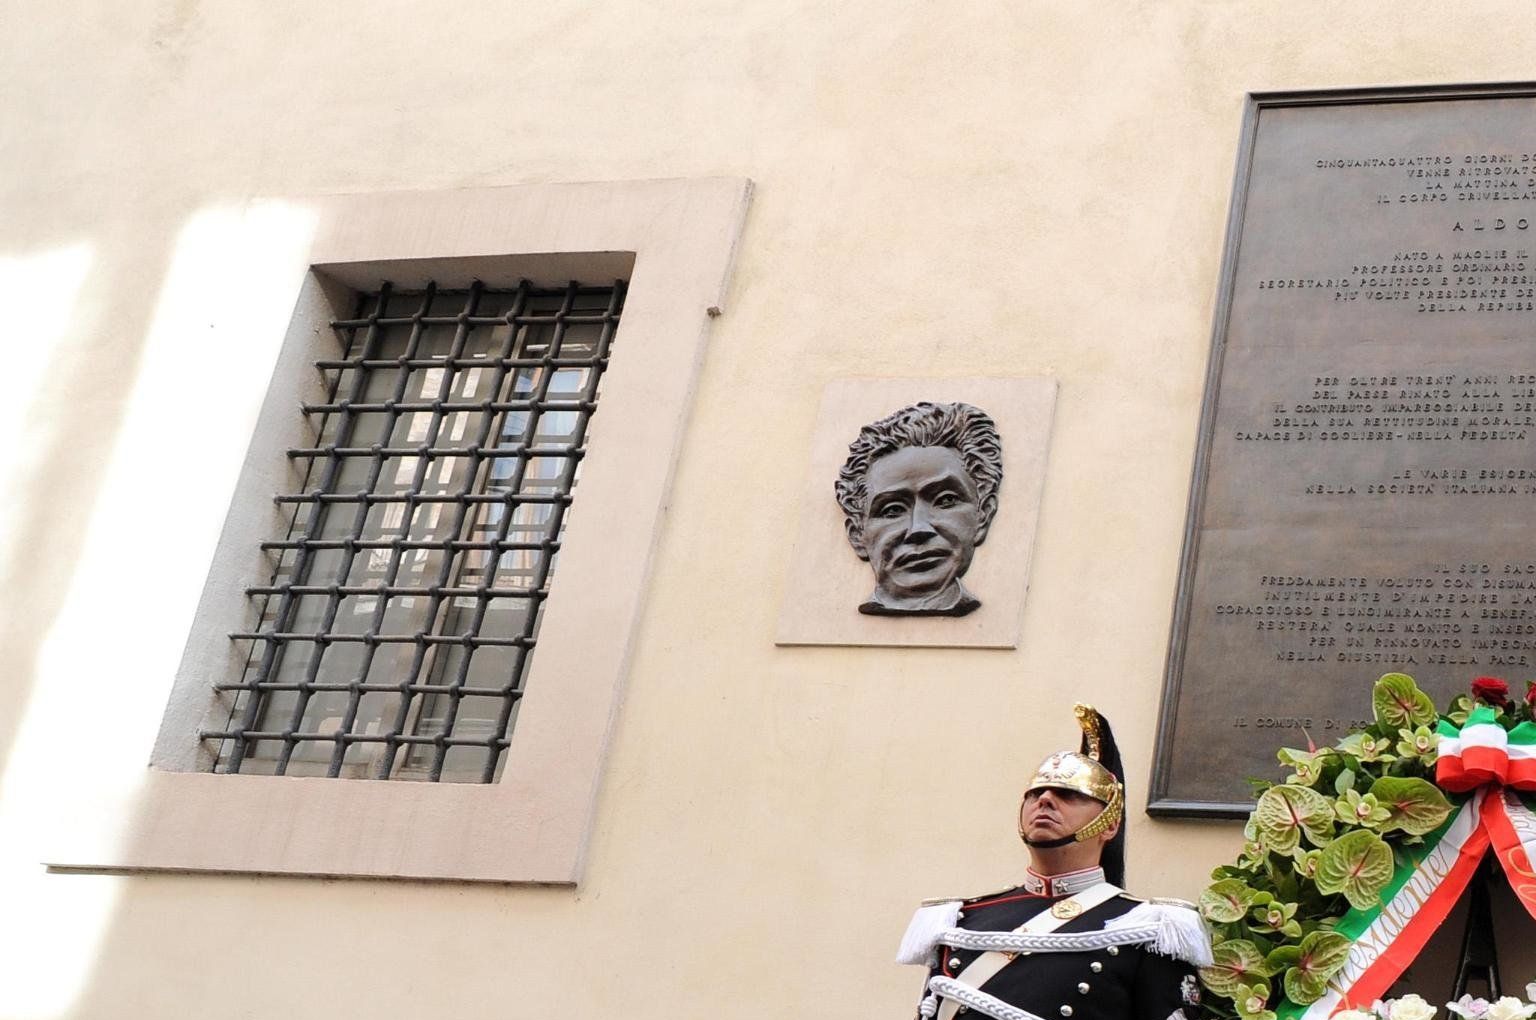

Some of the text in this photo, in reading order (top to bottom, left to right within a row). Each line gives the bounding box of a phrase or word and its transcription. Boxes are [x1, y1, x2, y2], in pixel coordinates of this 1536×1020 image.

[1316, 156, 1452, 168] CINQUANTAQUATTRO
[1464, 155, 1512, 164] GIORNI
[1407, 169, 1450, 177] VENNE
[1426, 181, 1442, 190] LA
[1453, 179, 1518, 189] MATTINA
[1377, 194, 1390, 204] IL
[1400, 193, 1448, 202] CORPO
[1452, 218, 1529, 231] ALDO
[1393, 252, 1428, 261] NATO
[1453, 250, 1508, 260] MAGLIE
[1517, 250, 1529, 259] IL
[1352, 264, 1443, 274] PROFESSORE
[1452, 262, 1526, 273] ORDINARIO
[1259, 278, 1350, 289] SEGRETARIO
[1360, 277, 1431, 287] POLITICO
[1456, 276, 1482, 286] POI
[1365, 290, 1410, 300] VOLTE
[1418, 289, 1506, 299] PRESIDENTE
[1418, 303, 1466, 312] DELLA
[1315, 377, 1340, 386] PER
[1349, 376, 1398, 386] OLTRE
[1313, 390, 1338, 400] DEL
[1347, 390, 1390, 400] PAESE
[1399, 389, 1451, 399] RINATO
[1462, 389, 1500, 398] ALLA
[1274, 403, 1286, 413] IL
[1295, 404, 1373, 413] CONTRIBUTO
[1382, 403, 1504, 413] IMPAREGGIABILE
[1273, 417, 1319, 427] DELLA
[1328, 417, 1354, 427] SUA
[1363, 417, 1459, 427] RETTITUDINE
[1234, 431, 1291, 441] CAPACE
[1297, 431, 1312, 441] DI
[1393, 470, 1411, 480] LE
[1420, 469, 1468, 480] VARIE
[1305, 485, 1357, 495] NELLA
[1445, 485, 1516, 495] ITALIANA
[1434, 564, 1450, 574] IL
[1459, 564, 1490, 574] SUO
[1260, 576, 1368, 588] FREDDAMENTE
[1376, 577, 1434, 588] VOLUTO
[1442, 578, 1475, 588] CON
[1264, 591, 1381, 602] INUTILMENTE
[1216, 605, 1313, 616] CORAGGIOSO
[1337, 607, 1451, 618] LUNGIMIRANTE
[1344, 622, 1396, 633] QUALE
[1404, 623, 1462, 634] MONITO
[1309, 637, 1336, 647] PER
[1347, 637, 1364, 648] UN
[1374, 638, 1462, 649] RINNOVATO
[1277, 652, 1325, 662] NELLA
[1427, 654, 1478, 665] NELLA
[1233, 717, 1368, 730] IL COMUNE DI RO
